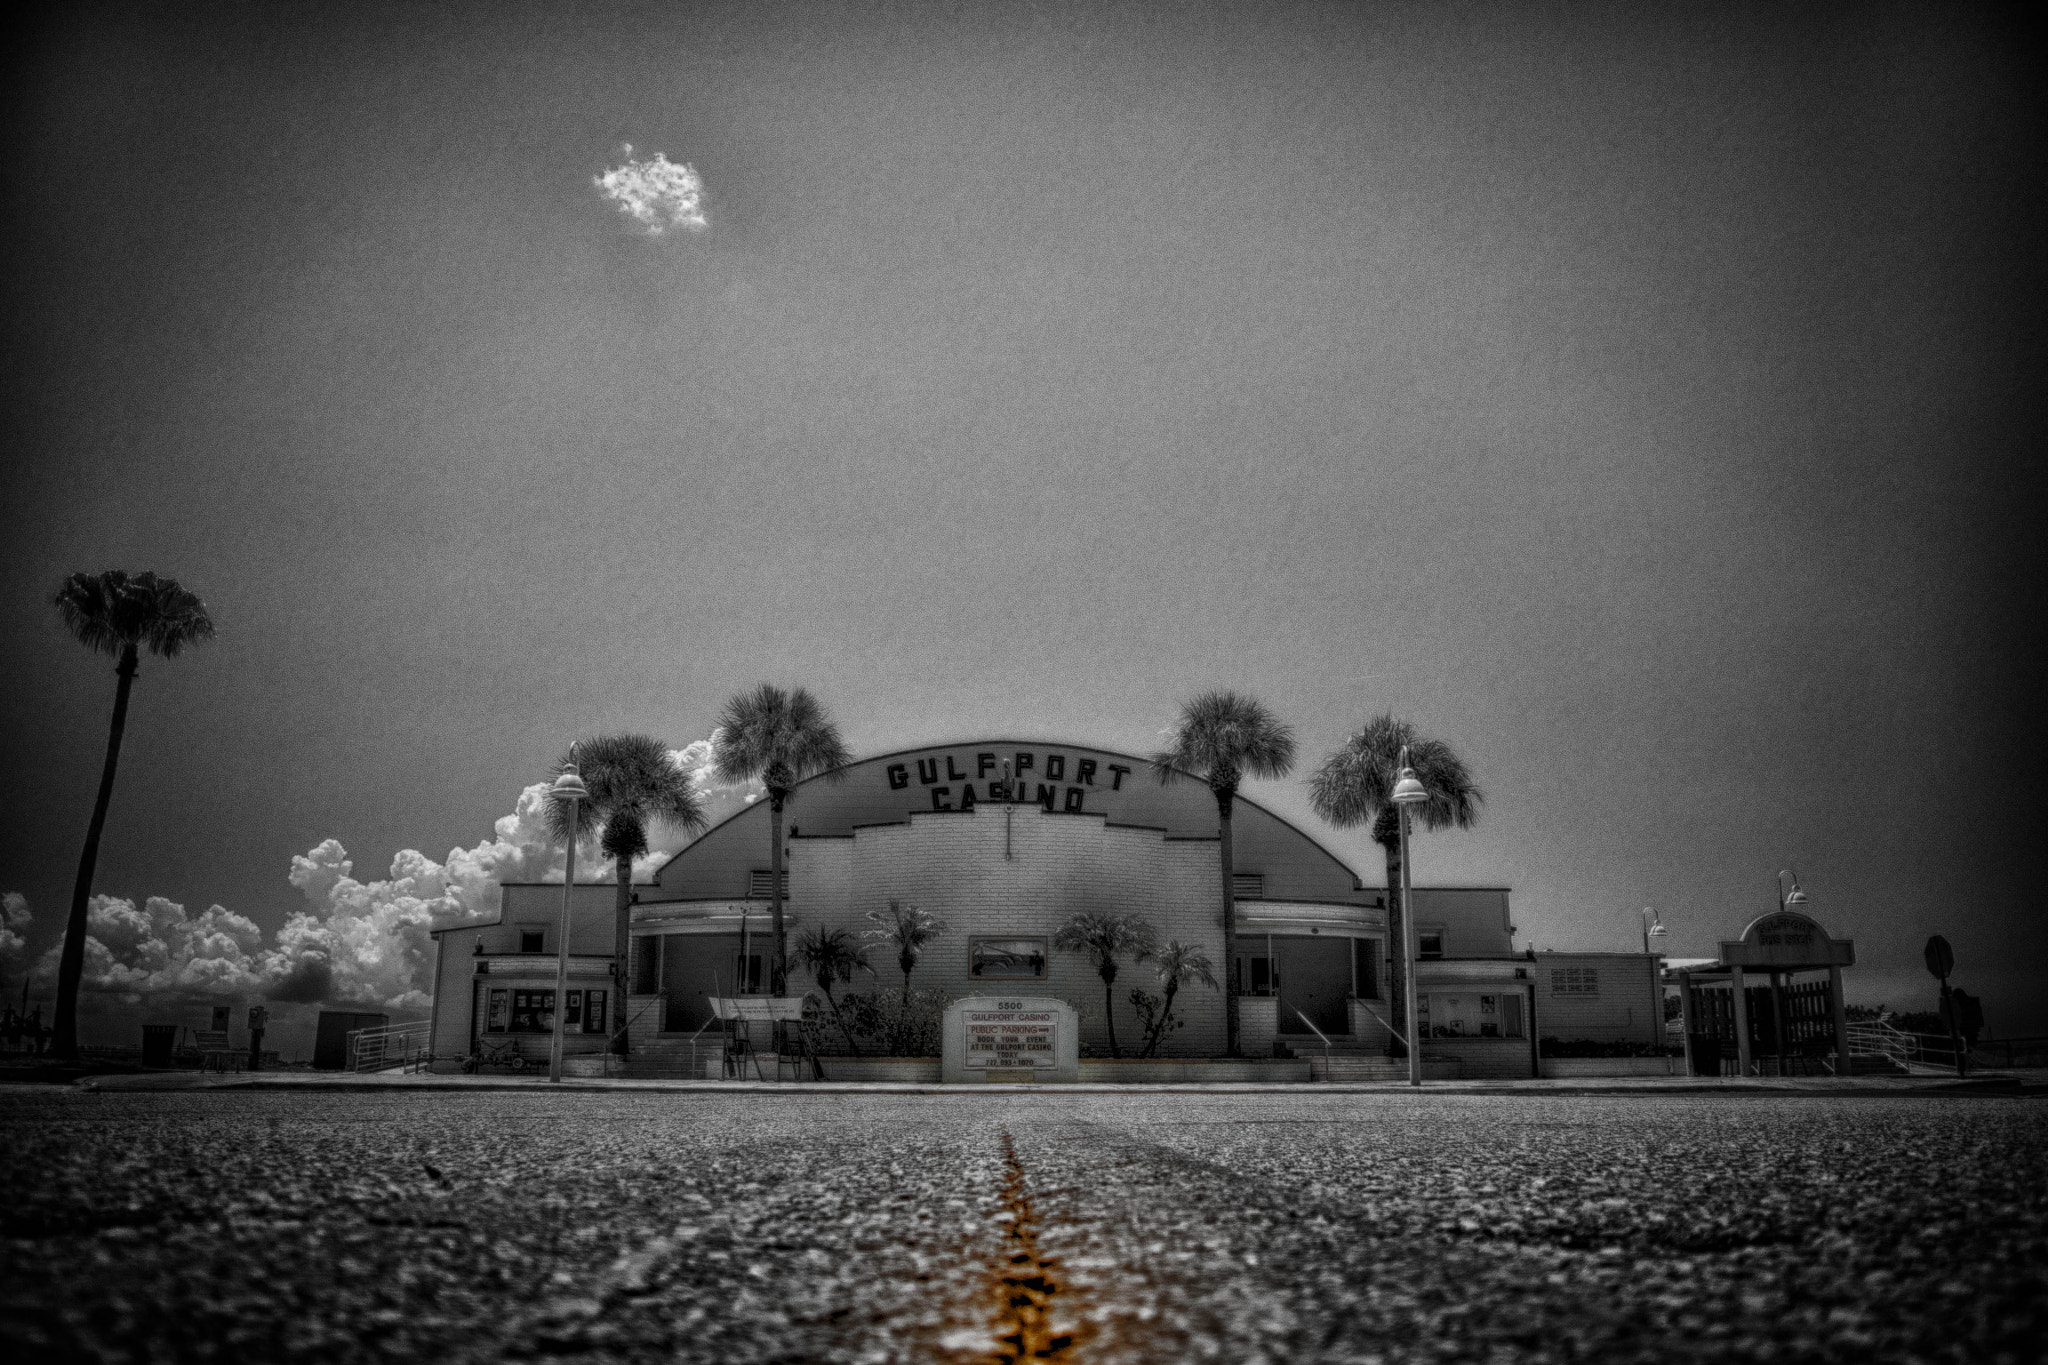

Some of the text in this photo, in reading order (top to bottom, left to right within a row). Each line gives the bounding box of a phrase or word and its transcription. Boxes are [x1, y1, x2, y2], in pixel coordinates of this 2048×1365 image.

[887, 752, 1131, 790] GULFPORT
[931, 781, 1084, 812] CASINO
[997, 1002, 1022, 1010] 5500
[971, 1013, 1050, 1021] GULFPORT CASINO
[971, 1025, 1038, 1034] PUBLIC PARKING
